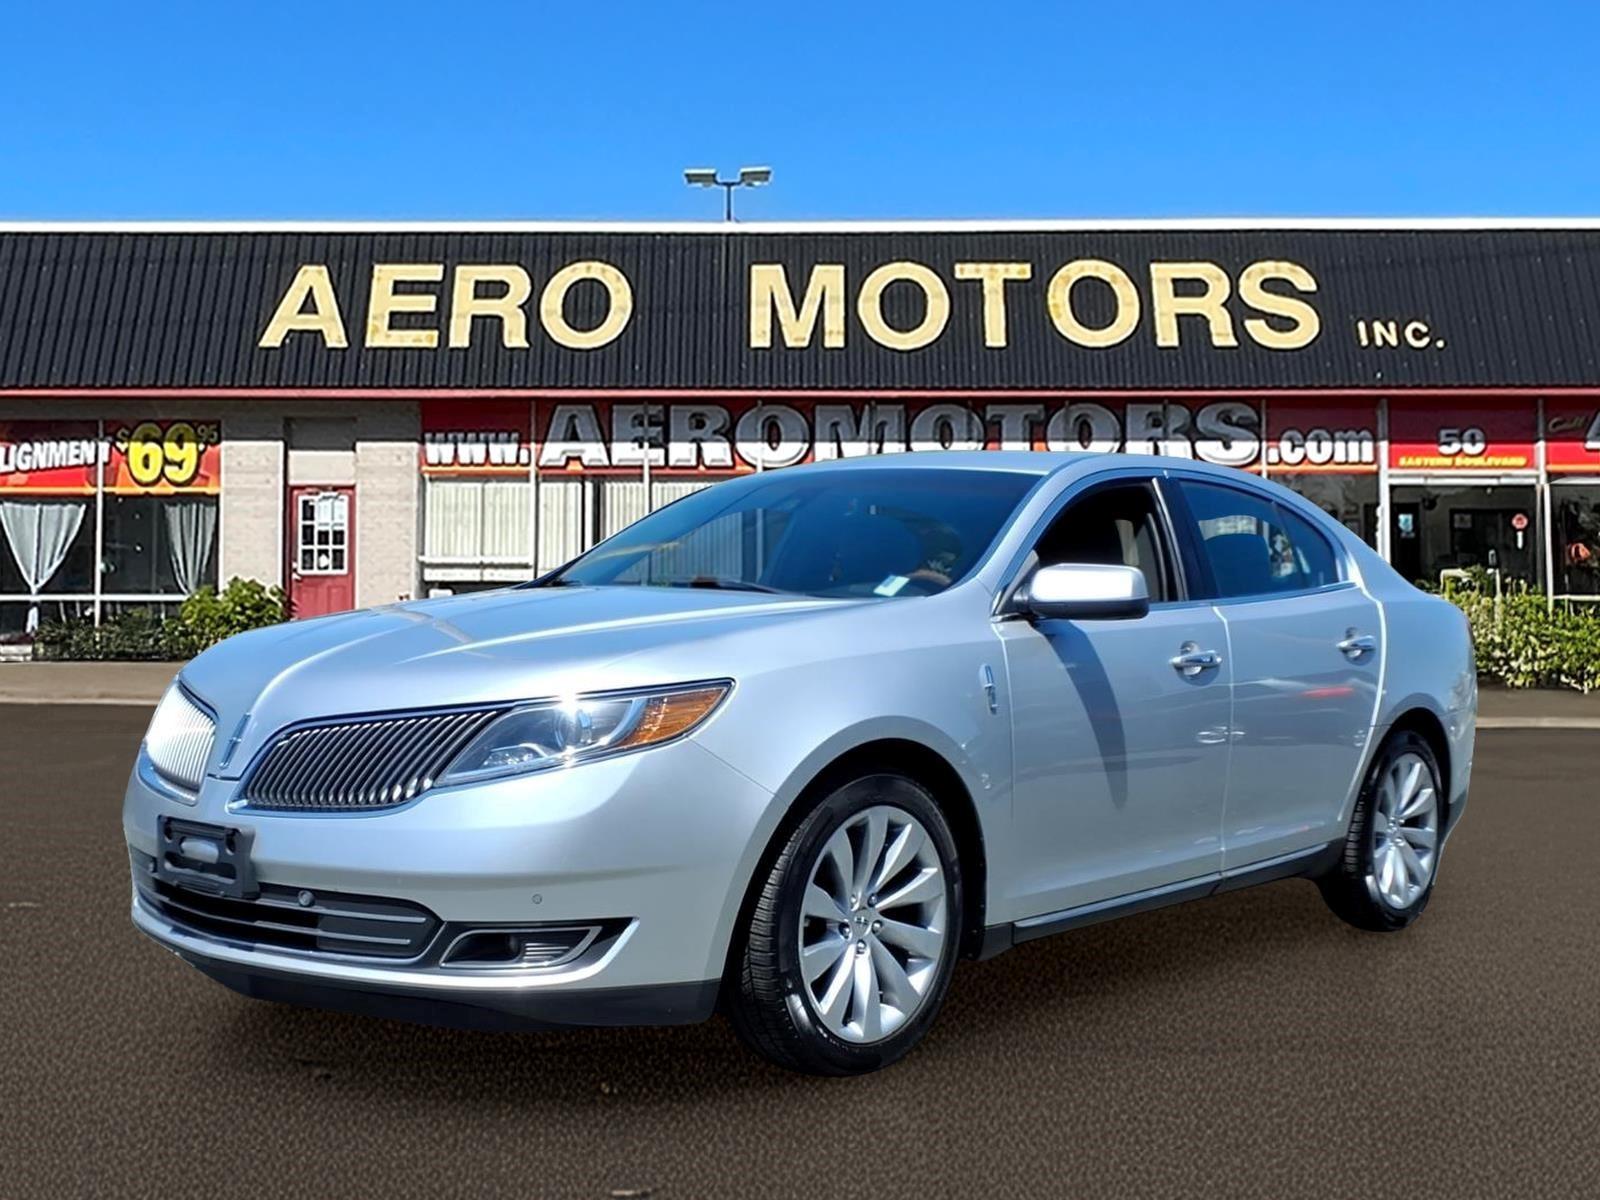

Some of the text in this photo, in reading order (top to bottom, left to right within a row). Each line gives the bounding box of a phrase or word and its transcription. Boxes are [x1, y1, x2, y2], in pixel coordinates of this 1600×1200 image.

[258, 259, 1446, 351] AERO MOTORS INC.
[1438, 427, 1486, 456] 50
